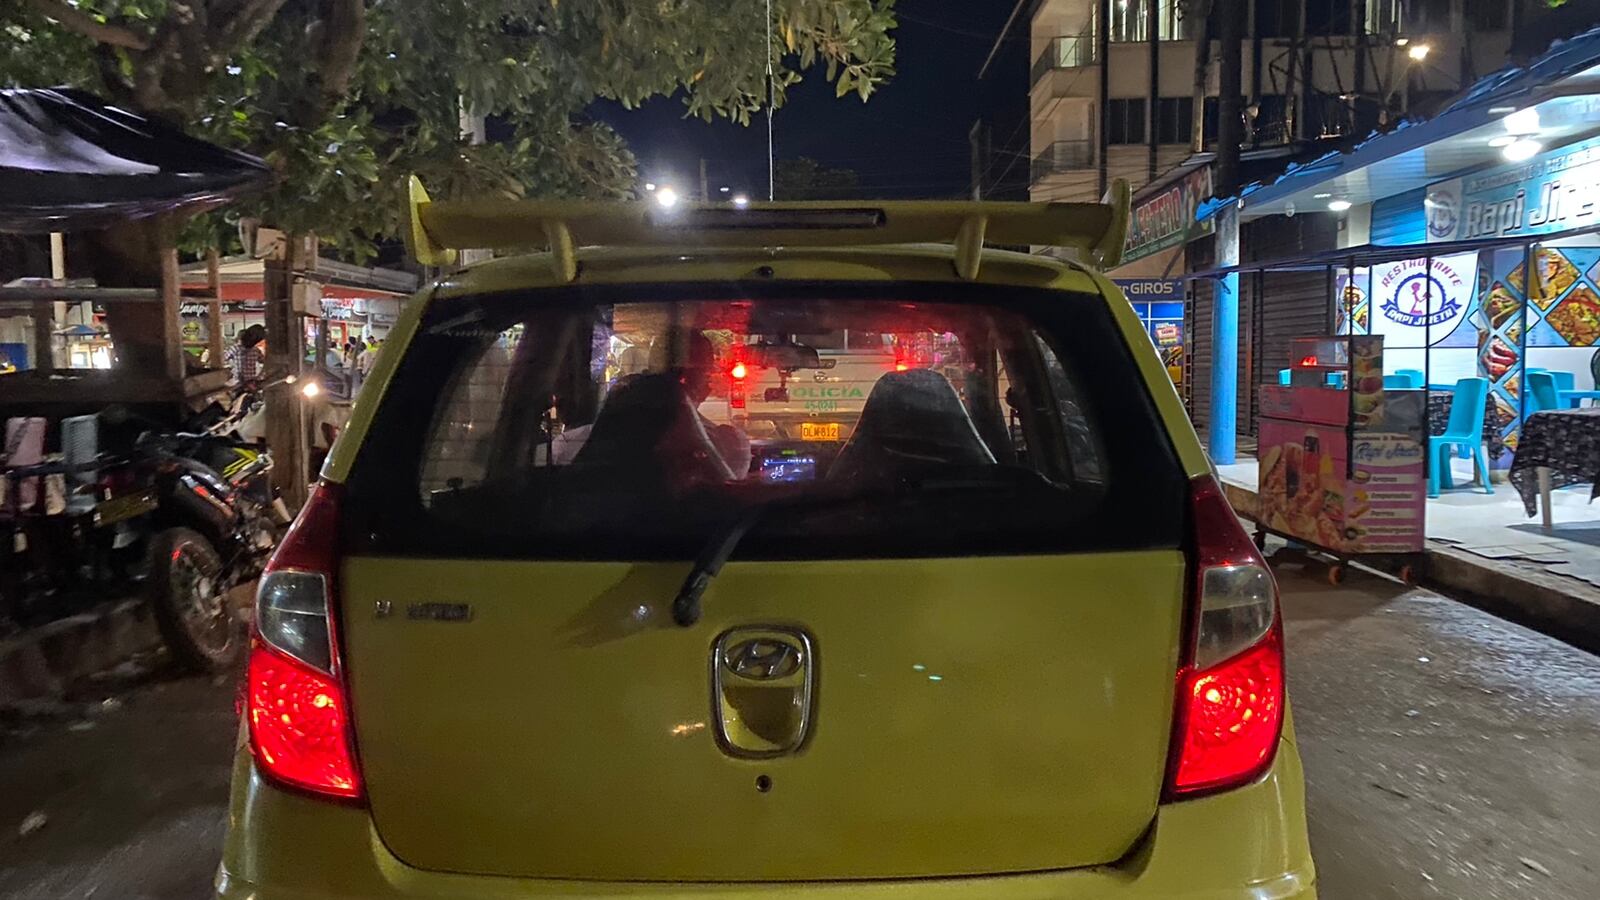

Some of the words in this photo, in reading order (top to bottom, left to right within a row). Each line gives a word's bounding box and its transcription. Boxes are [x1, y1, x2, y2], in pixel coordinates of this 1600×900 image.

[1465, 188, 1527, 238] Rapi
[1381, 258, 1463, 288] RESTAUANTE
[1386, 309, 1414, 325] RAPI
